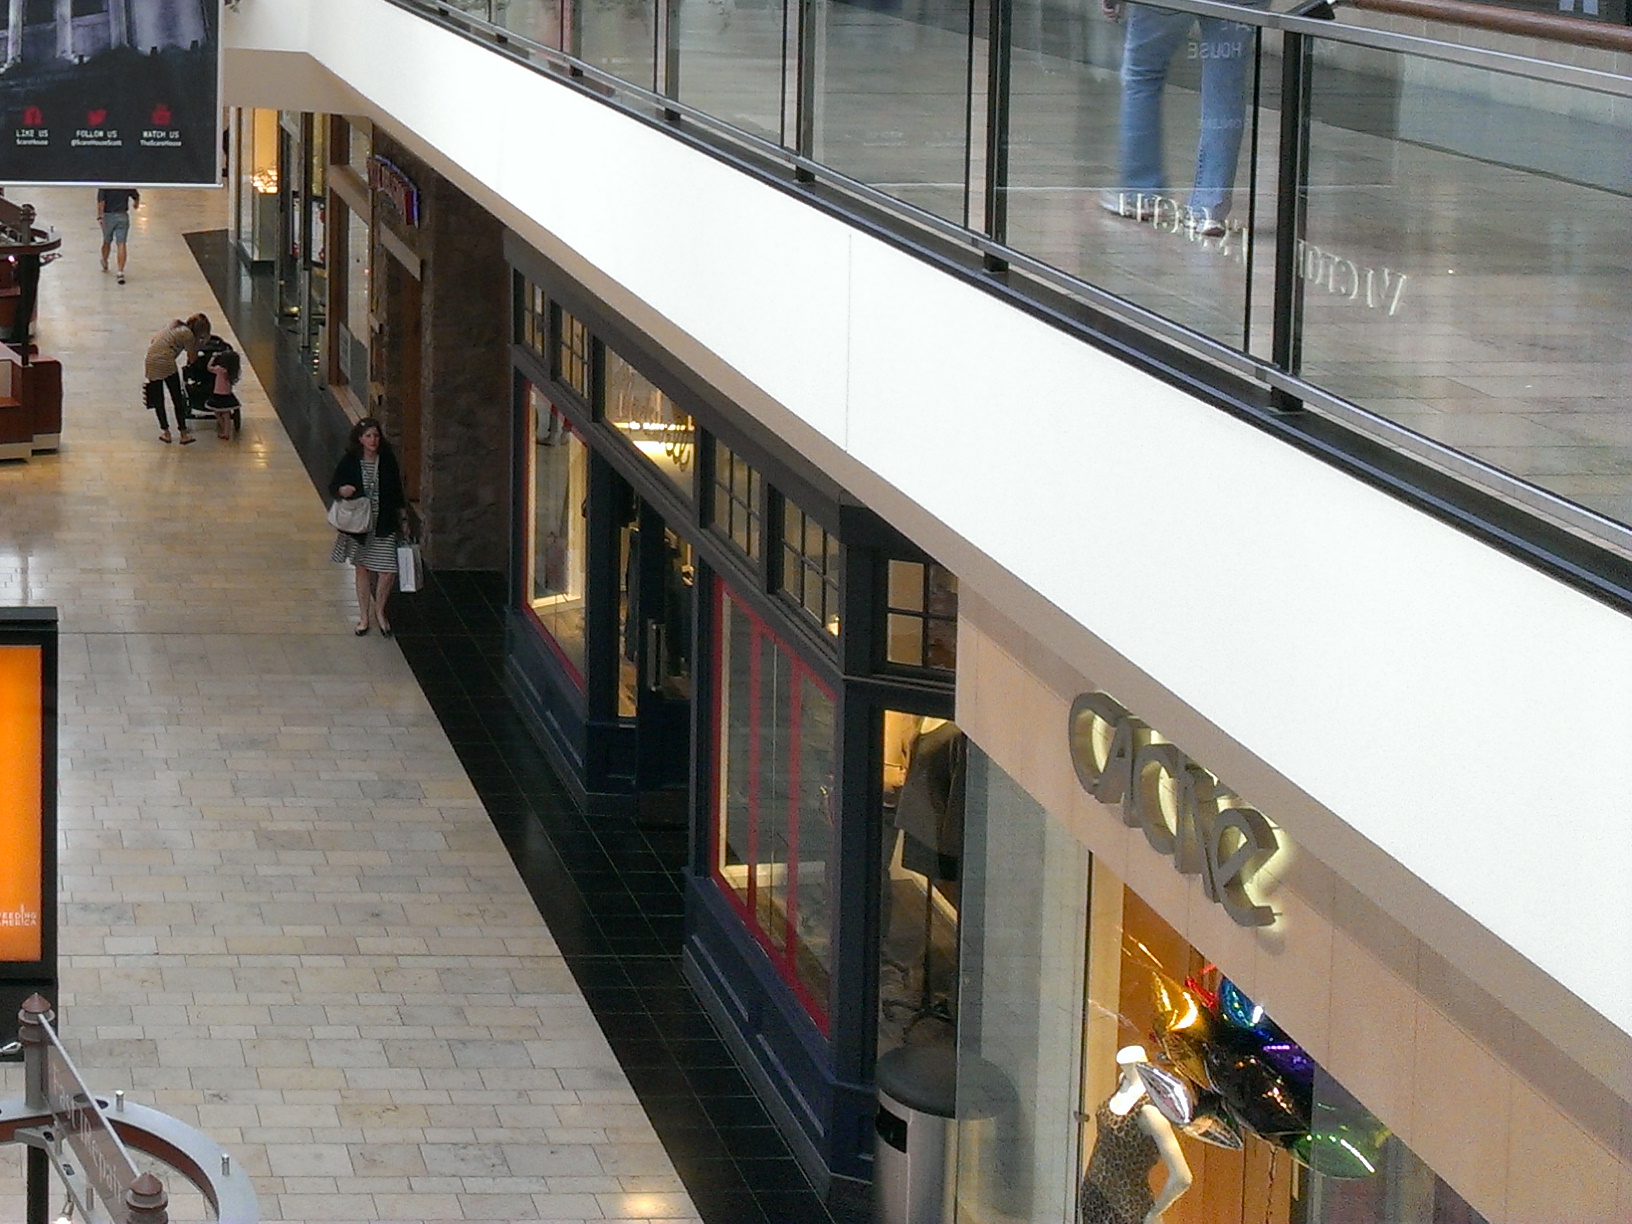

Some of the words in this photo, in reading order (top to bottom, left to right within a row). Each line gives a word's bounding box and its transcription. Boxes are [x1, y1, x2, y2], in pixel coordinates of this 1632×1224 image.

[16, 129, 35, 137] LIKE
[39, 129, 48, 137] US
[107, 130, 118, 138] US
[169, 131, 179, 139] US
